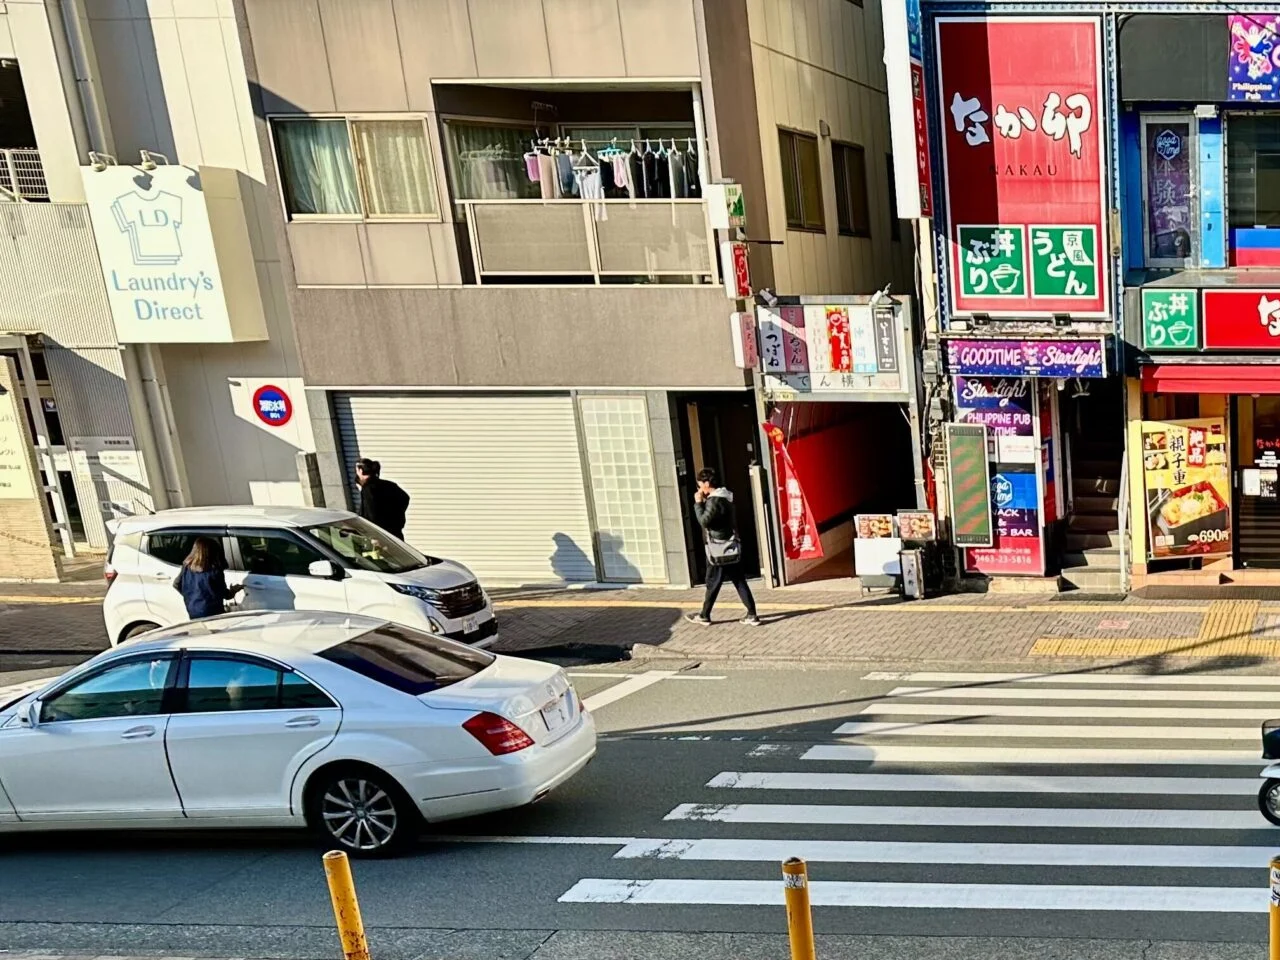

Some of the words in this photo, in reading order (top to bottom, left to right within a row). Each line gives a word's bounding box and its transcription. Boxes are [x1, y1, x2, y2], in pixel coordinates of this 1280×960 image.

[1232, 83, 1273, 91] Philippine
[1245, 92, 1261, 100] Pub
[950, 91, 1092, 159] なか卯
[990, 164, 1058, 176] NAKAU
[112, 269, 213, 299] Laundry's
[134, 299, 204, 320] Direct
[961, 347, 1021, 366] GOODTIME
[1042, 346, 1101, 372] Starlight
[967, 413, 1011, 425] PHILIPPINE
[1013, 413, 1031, 425] PUB
[1169, 434, 1187, 486] 親子重
[1011, 528, 1033, 537] BAR
